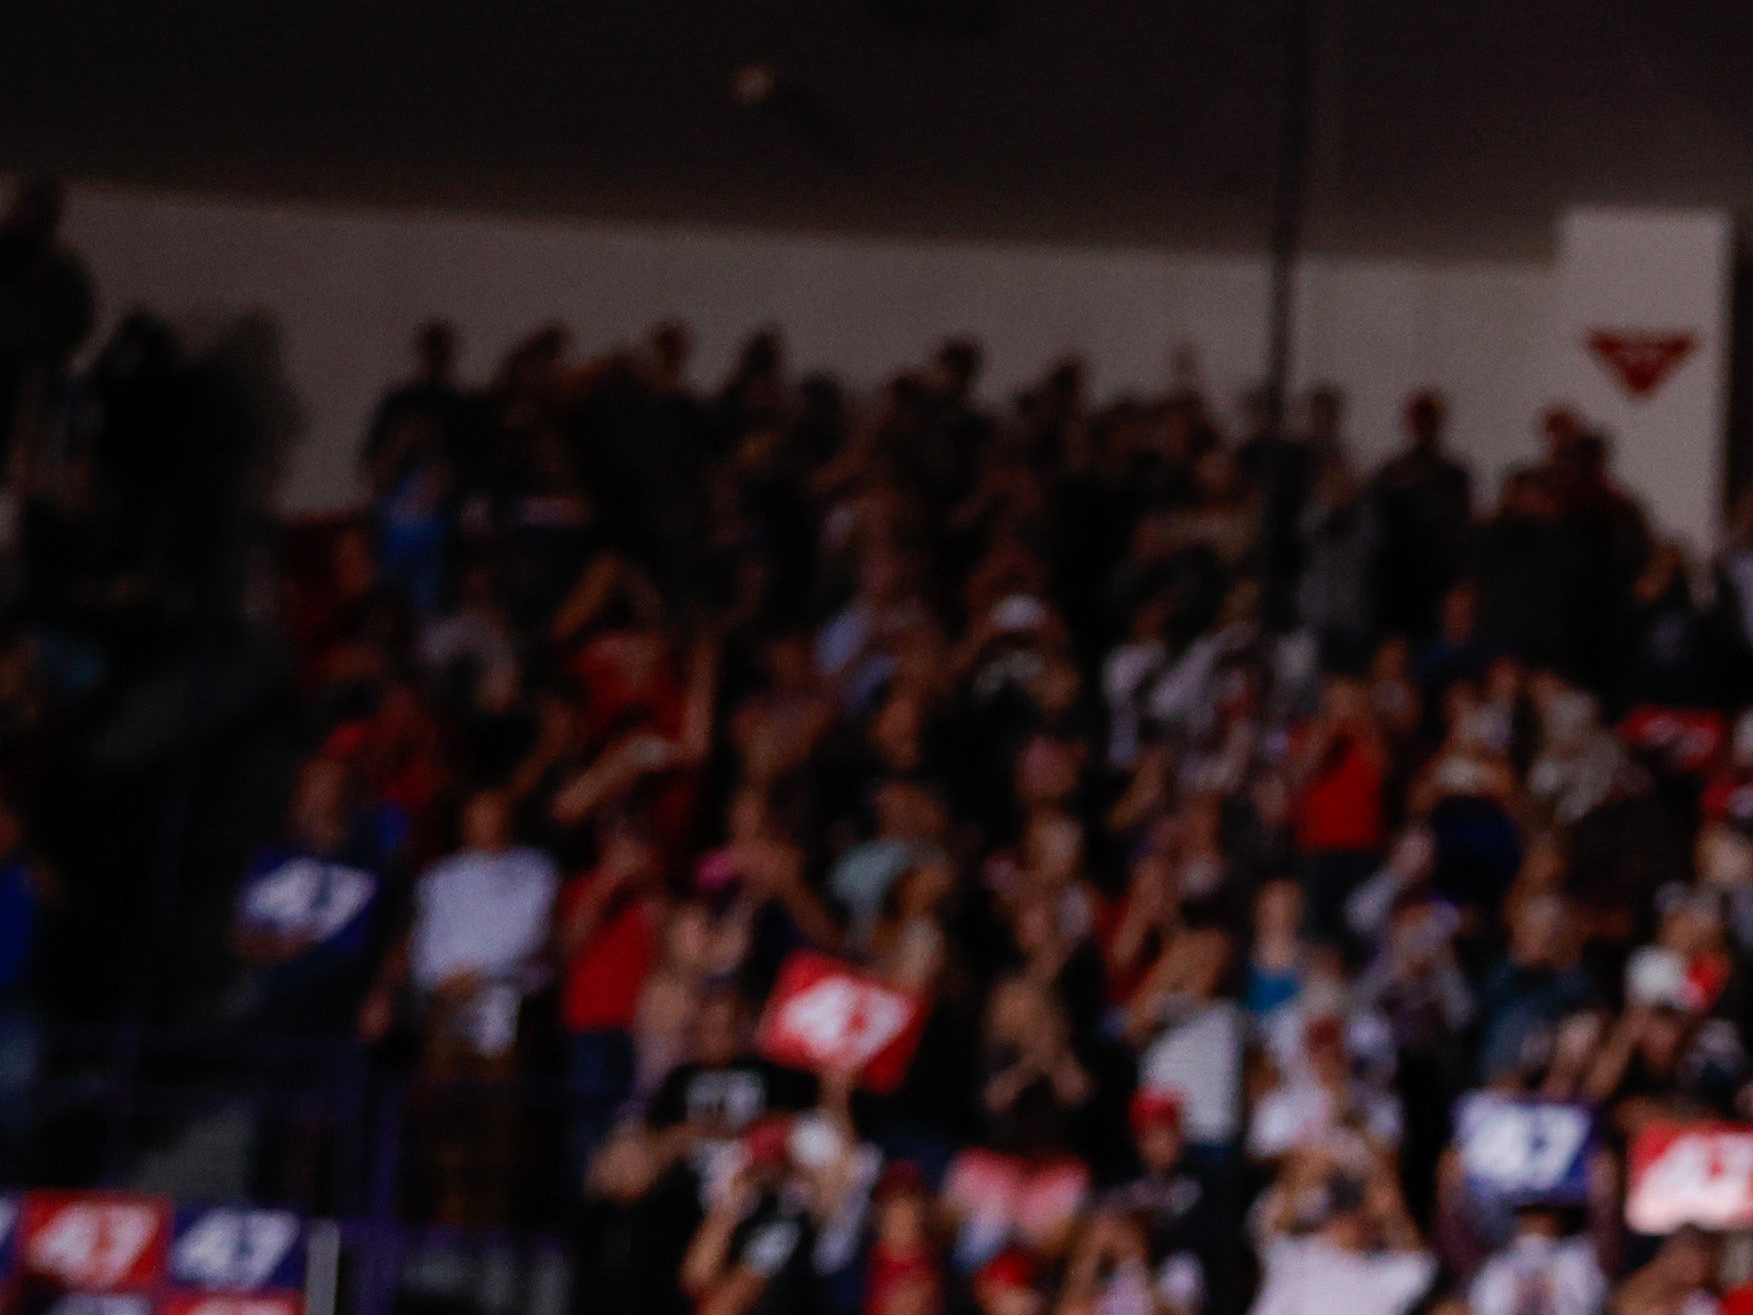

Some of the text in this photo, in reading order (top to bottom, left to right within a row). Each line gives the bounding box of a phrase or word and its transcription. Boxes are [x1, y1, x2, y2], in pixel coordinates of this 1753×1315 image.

[780, 972, 914, 1068] 47
[1460, 1097, 1592, 1192] 47
[26, 1199, 160, 1290] 47
[165, 1205, 300, 1291] 47
